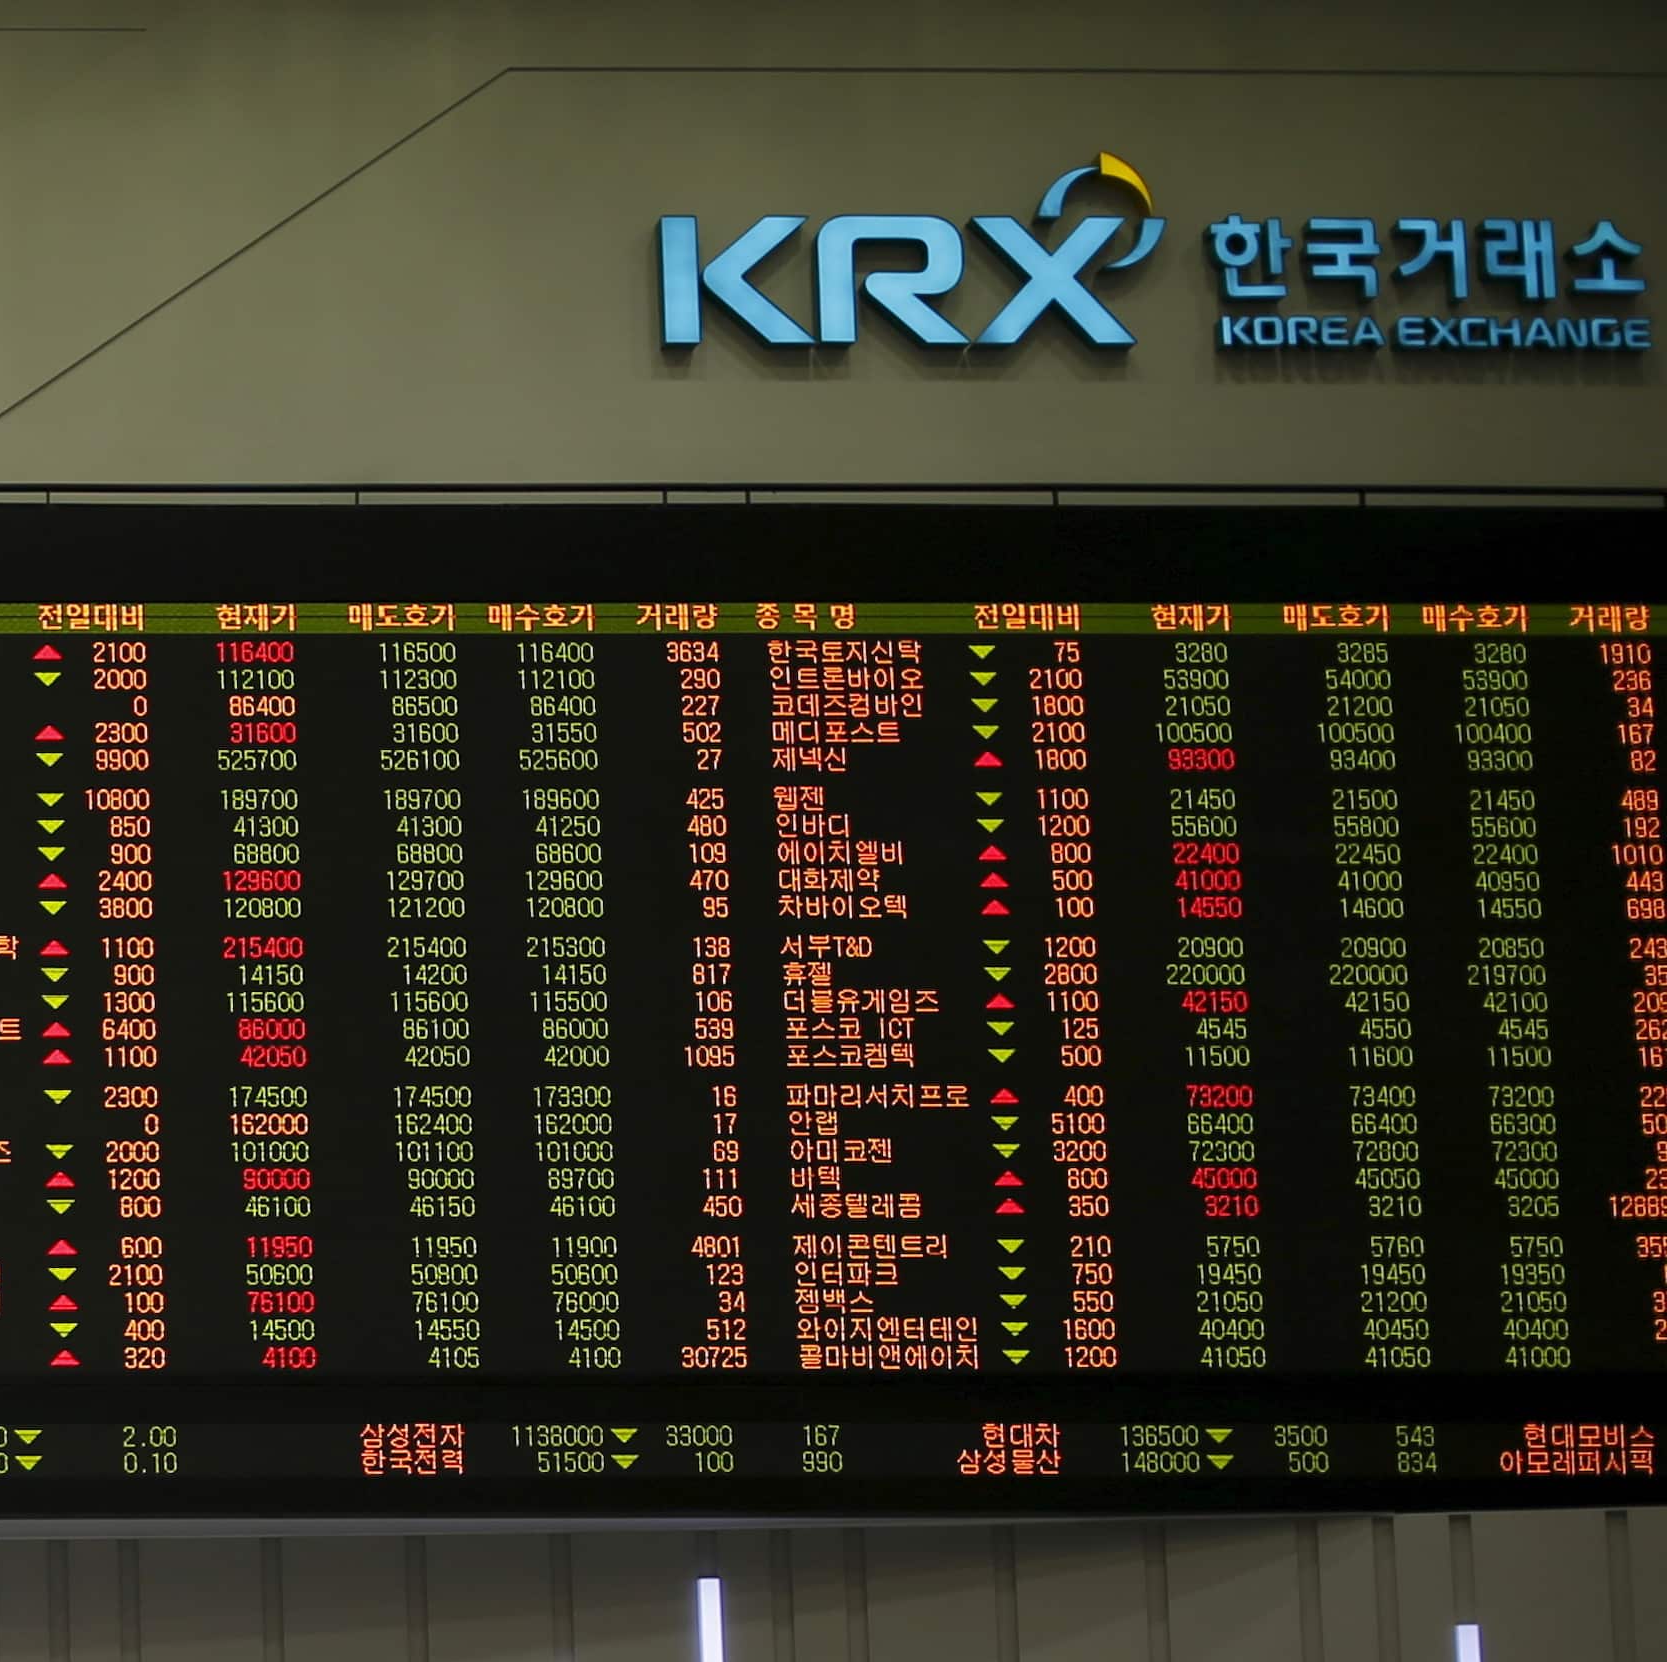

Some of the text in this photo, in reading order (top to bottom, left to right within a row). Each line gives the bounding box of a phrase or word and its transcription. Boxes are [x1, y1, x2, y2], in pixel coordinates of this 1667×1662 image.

[1208, 214, 1647, 300] 한국거래소
[658, 212, 1137, 347] KRX
[1220, 315, 1651, 349] KOREA EXCHANGE
[38, 604, 144, 632] 전일대비
[636, 603, 719, 632] 거래량
[92, 641, 147, 664] 2100
[215, 640, 295, 664] 116400
[379, 641, 457, 663] 116500
[517, 641, 595, 663] 116400
[666, 640, 721, 663] 3634
[766, 639, 1652, 665] 한국토지신탁 75 3280 3285 3280 1910
[771, 719, 1655, 745] 메디포스트 2100 100500 100500 100400 167
[109, 815, 151, 838] 850
[233, 815, 299, 838] 41300
[396, 815, 463, 838] 41300
[535, 815, 601, 837] 41250
[686, 814, 728, 838] 480
[775, 813, 1661, 839] 인바디 1200 55600 55800 55600 192
[104, 1044, 158, 1068] 1100
[239, 1044, 308, 1069] 42050
[404, 1045, 471, 1068] 42050
[544, 1045, 610, 1068] 42000
[682, 1044, 735, 1069] 1095
[792, 1233, 1564, 1260] 제이콘텐트리 210 5750 5760 5750
[123, 1318, 166, 1342] 400
[249, 1318, 316, 1341] 14500
[414, 1318, 481, 1341] 14550
[554, 1318, 621, 1341] 14500
[706, 1317, 747, 1341] 512
[981, 1422, 1435, 1449] 현대차 136500 3500 543
[360, 1449, 843, 1475] 한국전력 51500 100 990
